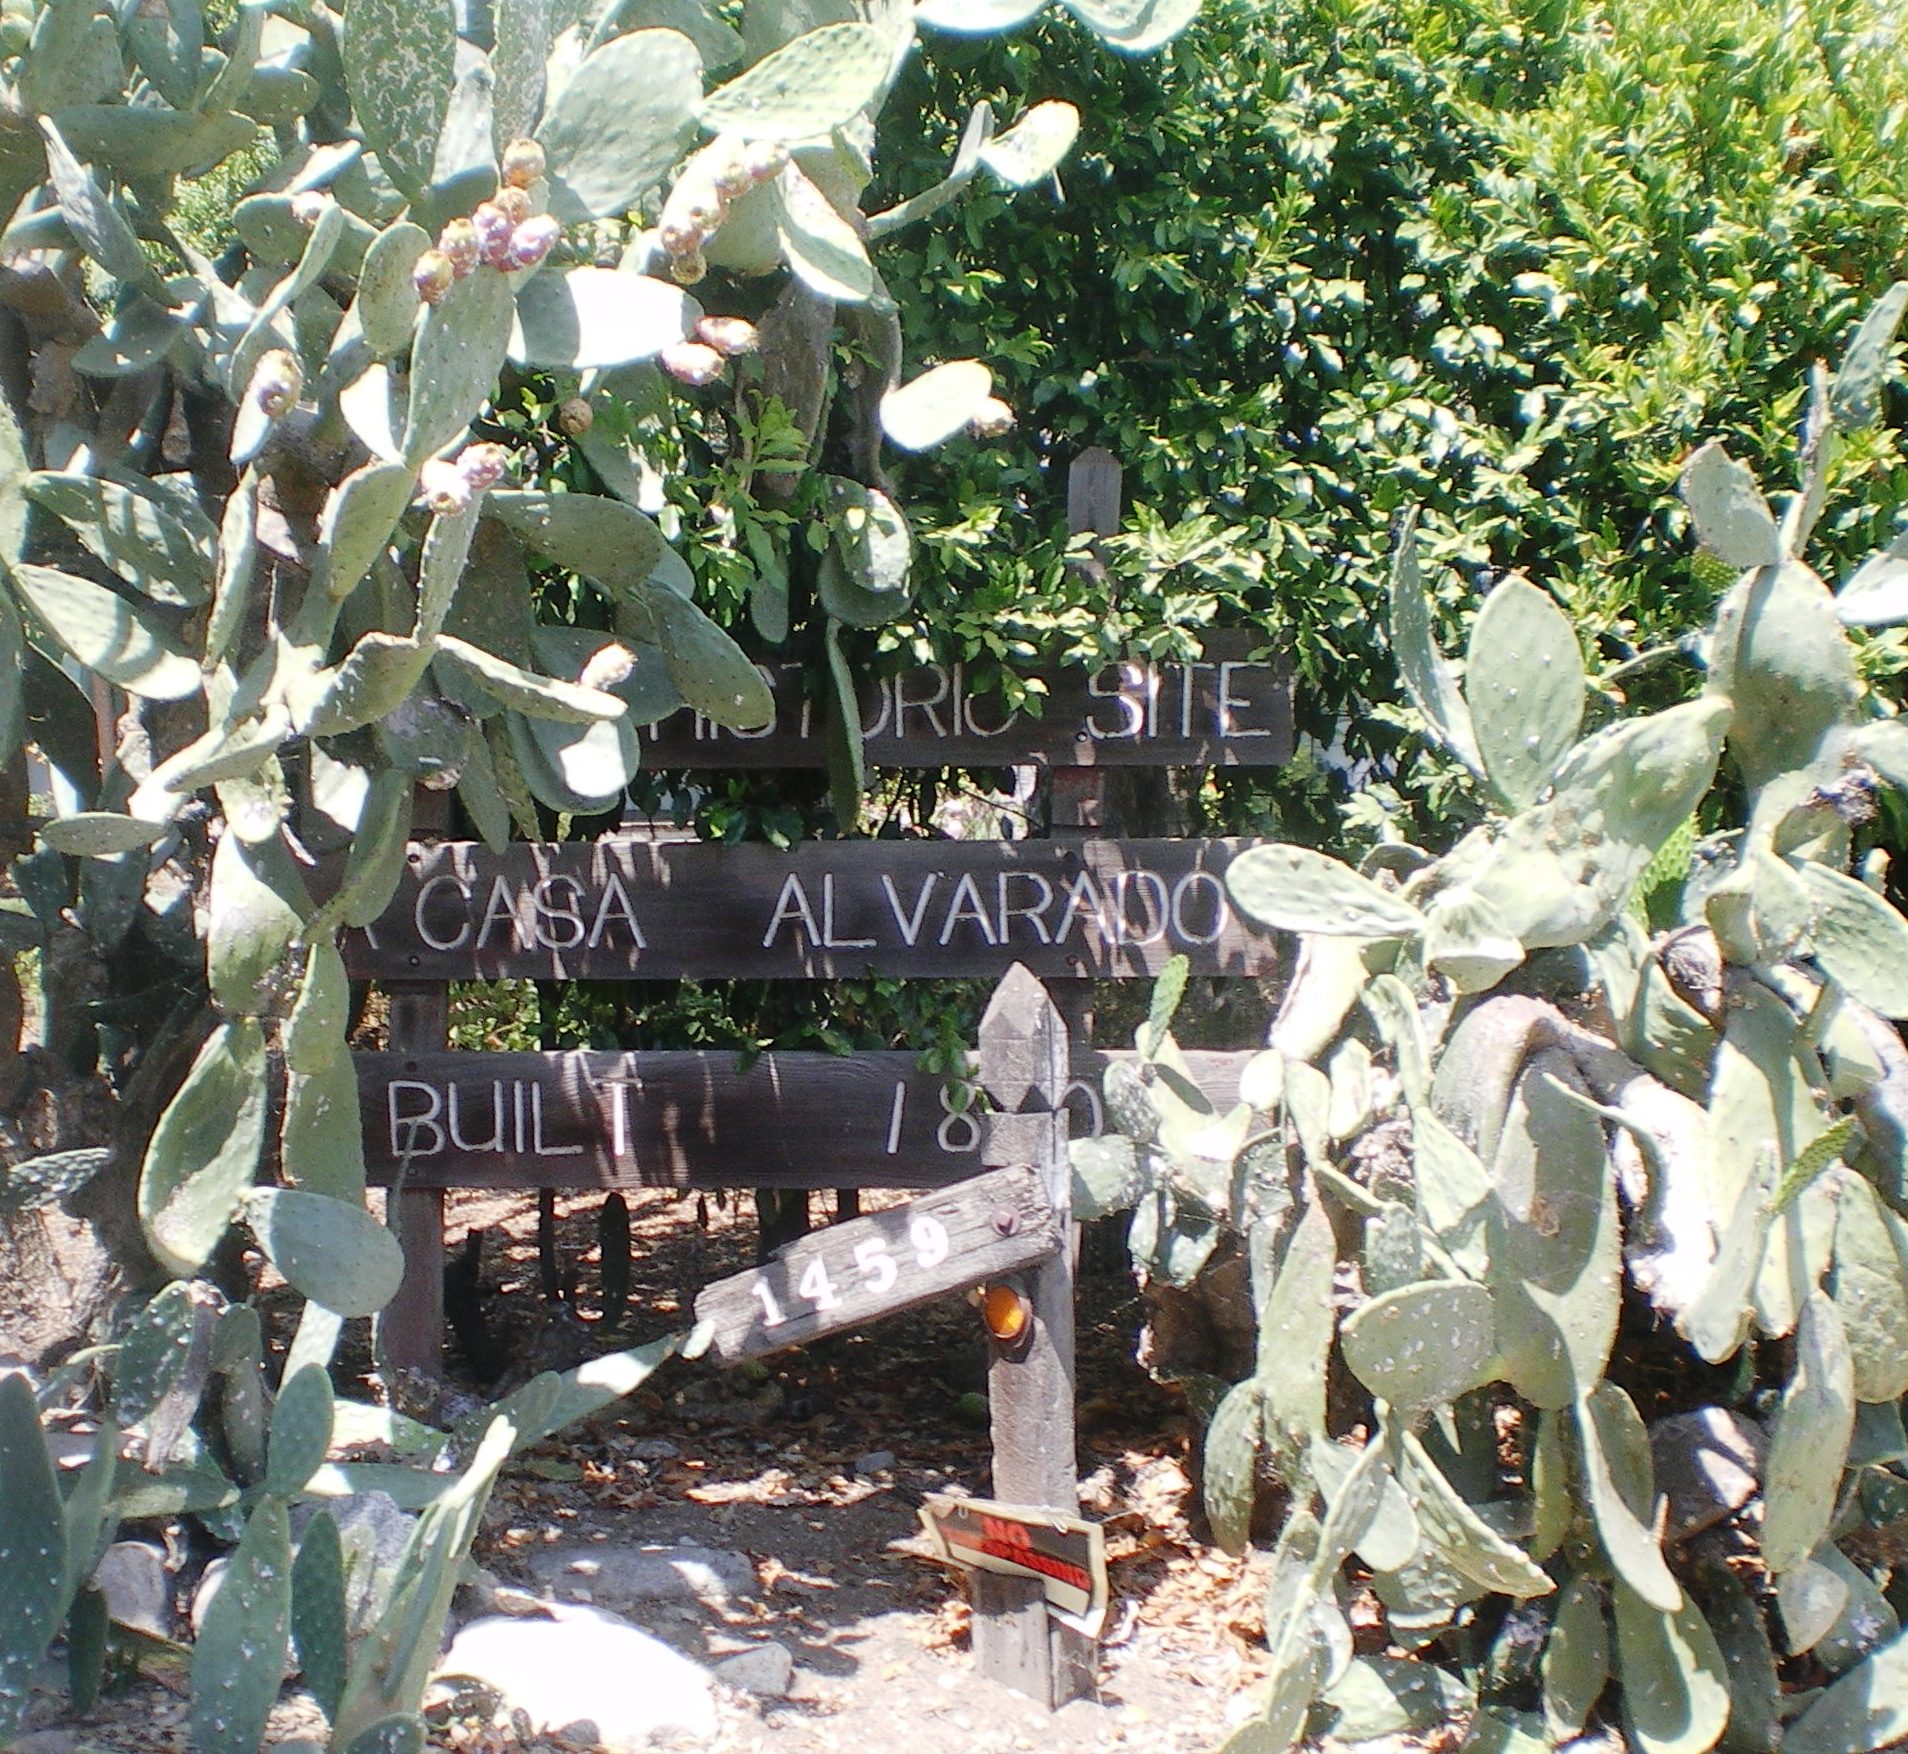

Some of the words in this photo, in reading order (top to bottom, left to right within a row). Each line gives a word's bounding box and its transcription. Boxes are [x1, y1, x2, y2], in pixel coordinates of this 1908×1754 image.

[1085, 660, 1272, 740] SITE
[415, 872, 648, 951] CASA
[762, 870, 1227, 949] ALVARADO
[387, 1077, 643, 1157] BUILT
[752, 1215, 950, 1327] 1459
